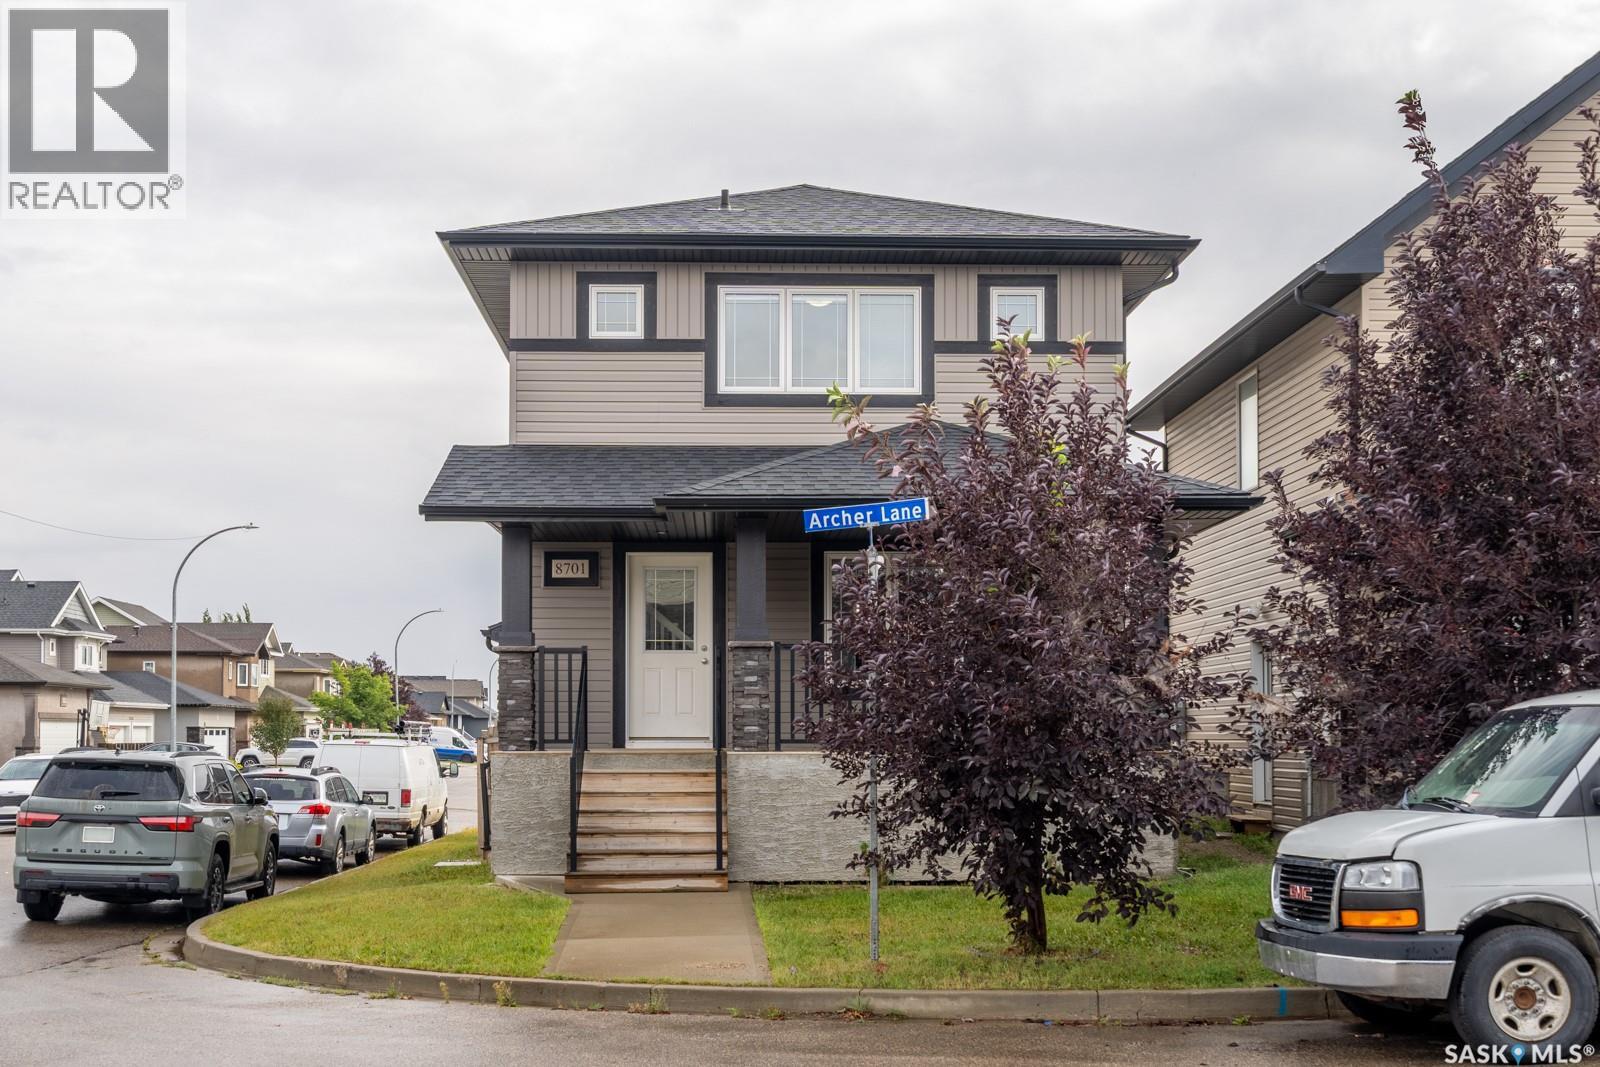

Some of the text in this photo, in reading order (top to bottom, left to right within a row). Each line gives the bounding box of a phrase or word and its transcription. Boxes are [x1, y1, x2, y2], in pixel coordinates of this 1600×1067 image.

[809, 505, 922, 528] Archer Lane
[555, 562, 585, 575] 8701
[1289, 884, 1313, 902] GMC
